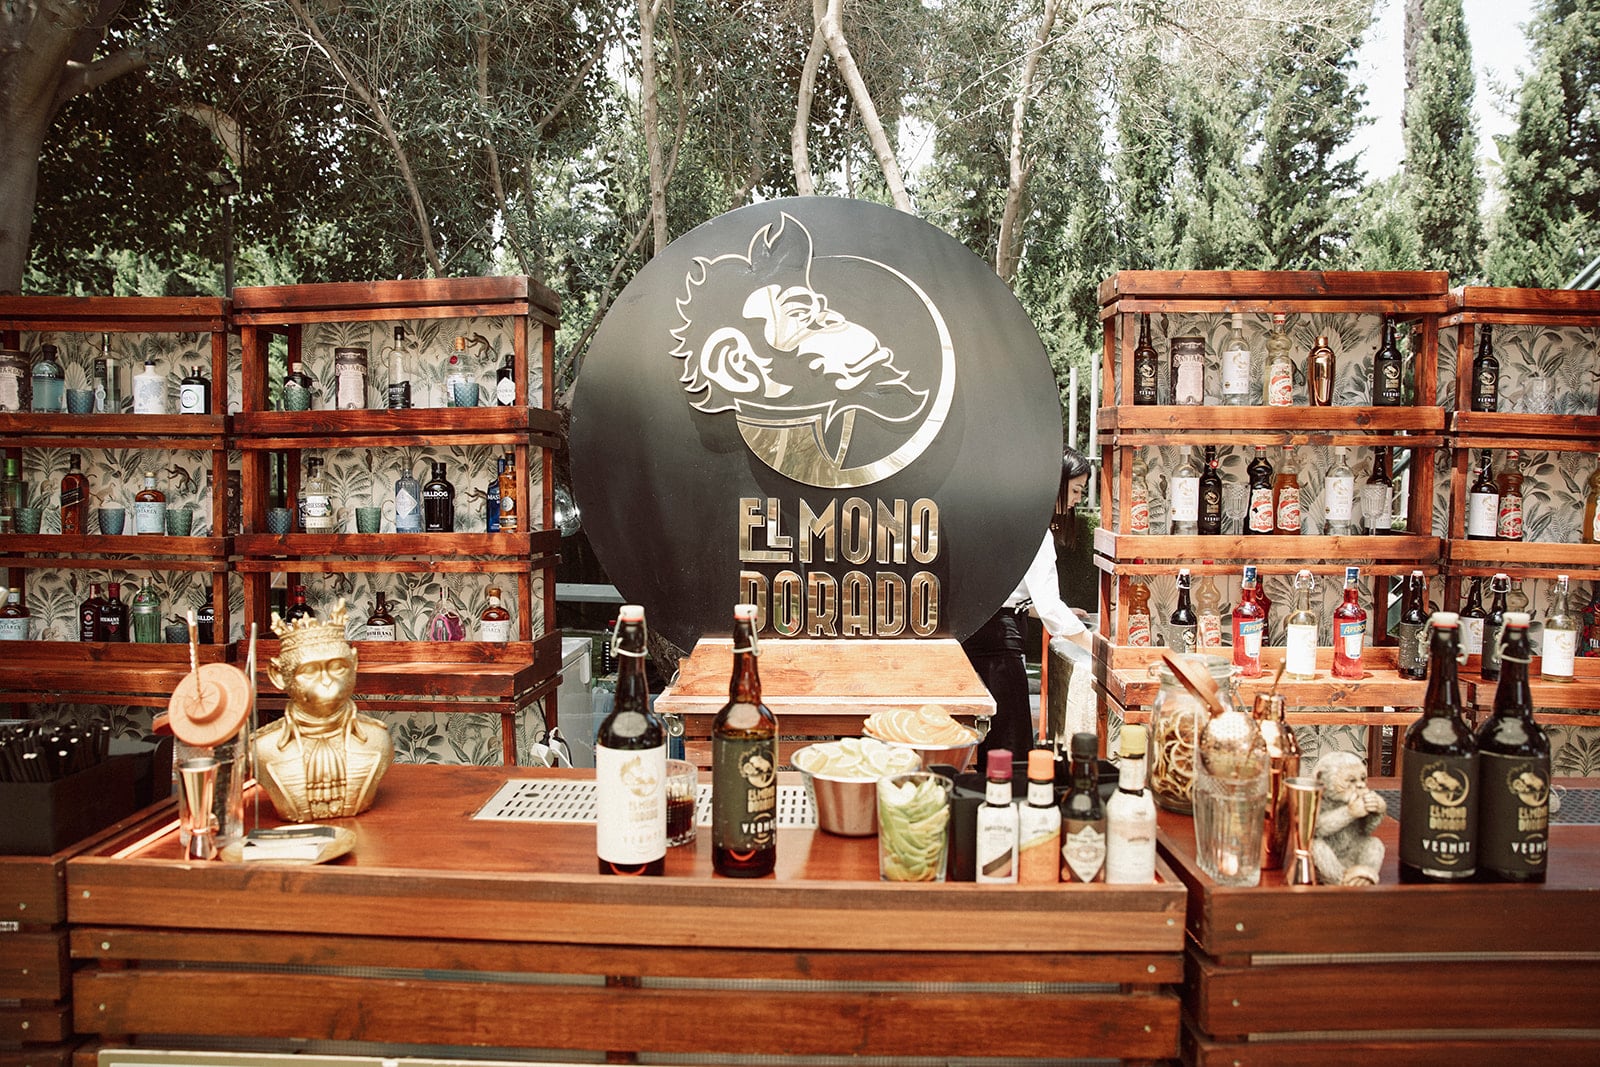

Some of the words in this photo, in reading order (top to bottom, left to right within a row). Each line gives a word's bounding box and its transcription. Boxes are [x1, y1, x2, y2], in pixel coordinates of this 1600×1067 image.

[739, 497, 793, 563] EL
[799, 497, 940, 564] MONO
[739, 570, 941, 637] DORADO
[1422, 838, 1470, 854] VERMUT
